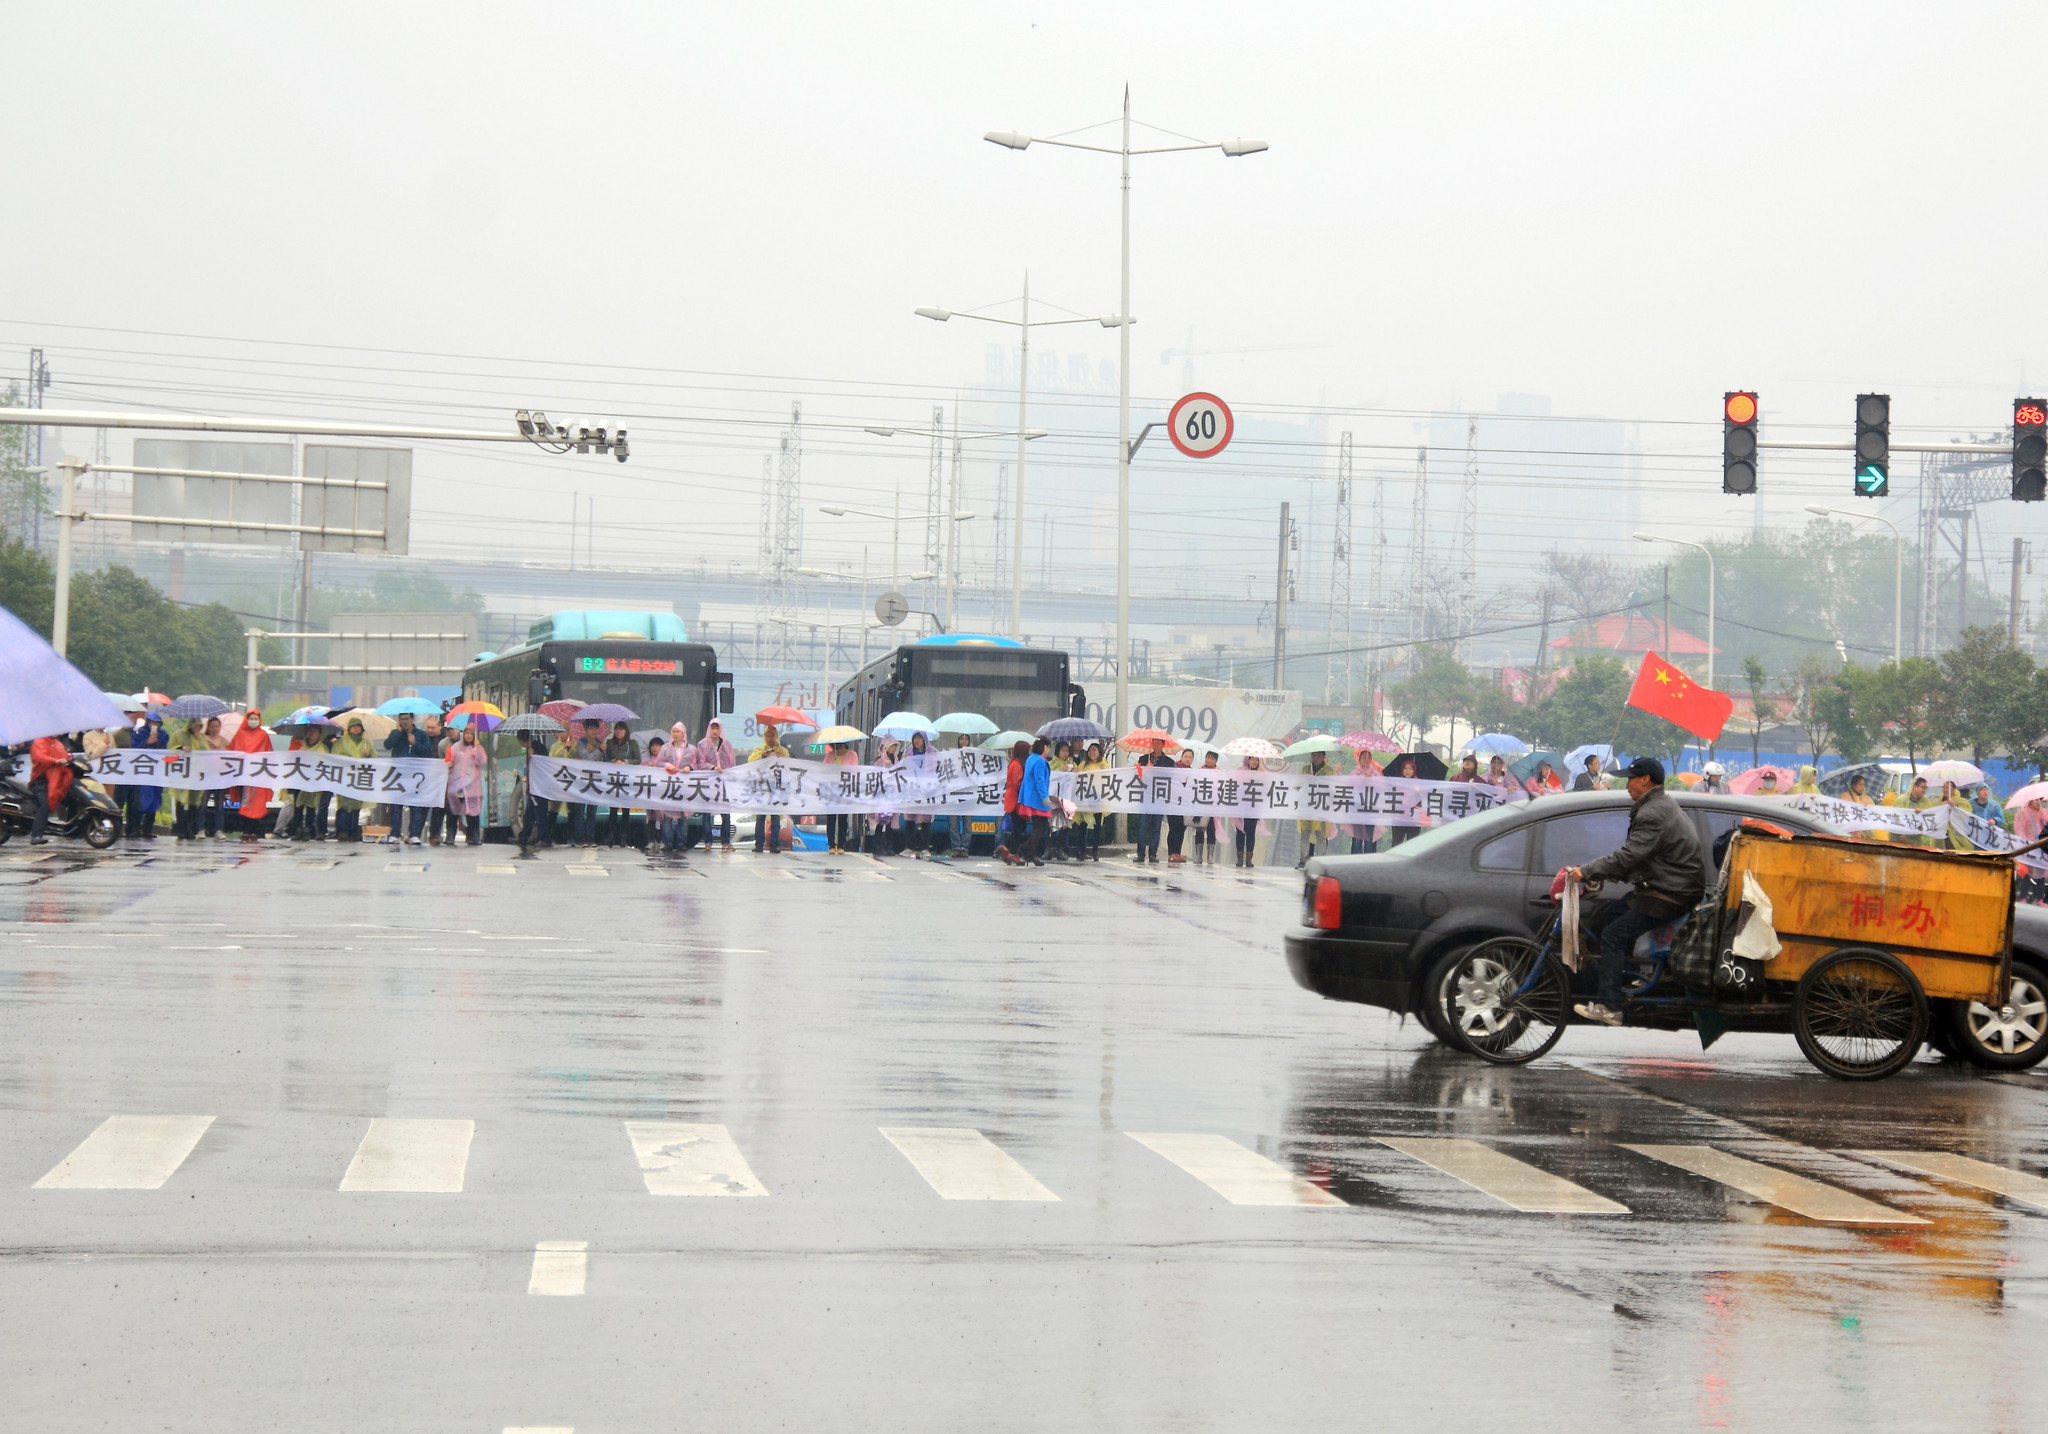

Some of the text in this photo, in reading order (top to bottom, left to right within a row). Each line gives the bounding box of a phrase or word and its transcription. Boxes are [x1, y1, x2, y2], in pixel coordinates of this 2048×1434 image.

[1186, 410, 1216, 440] 60
[583, 657, 603, 671] B2
[1133, 704, 1218, 743] 9999
[802, 816, 815, 825] 71
[1849, 893, 1936, 932] 桐办
